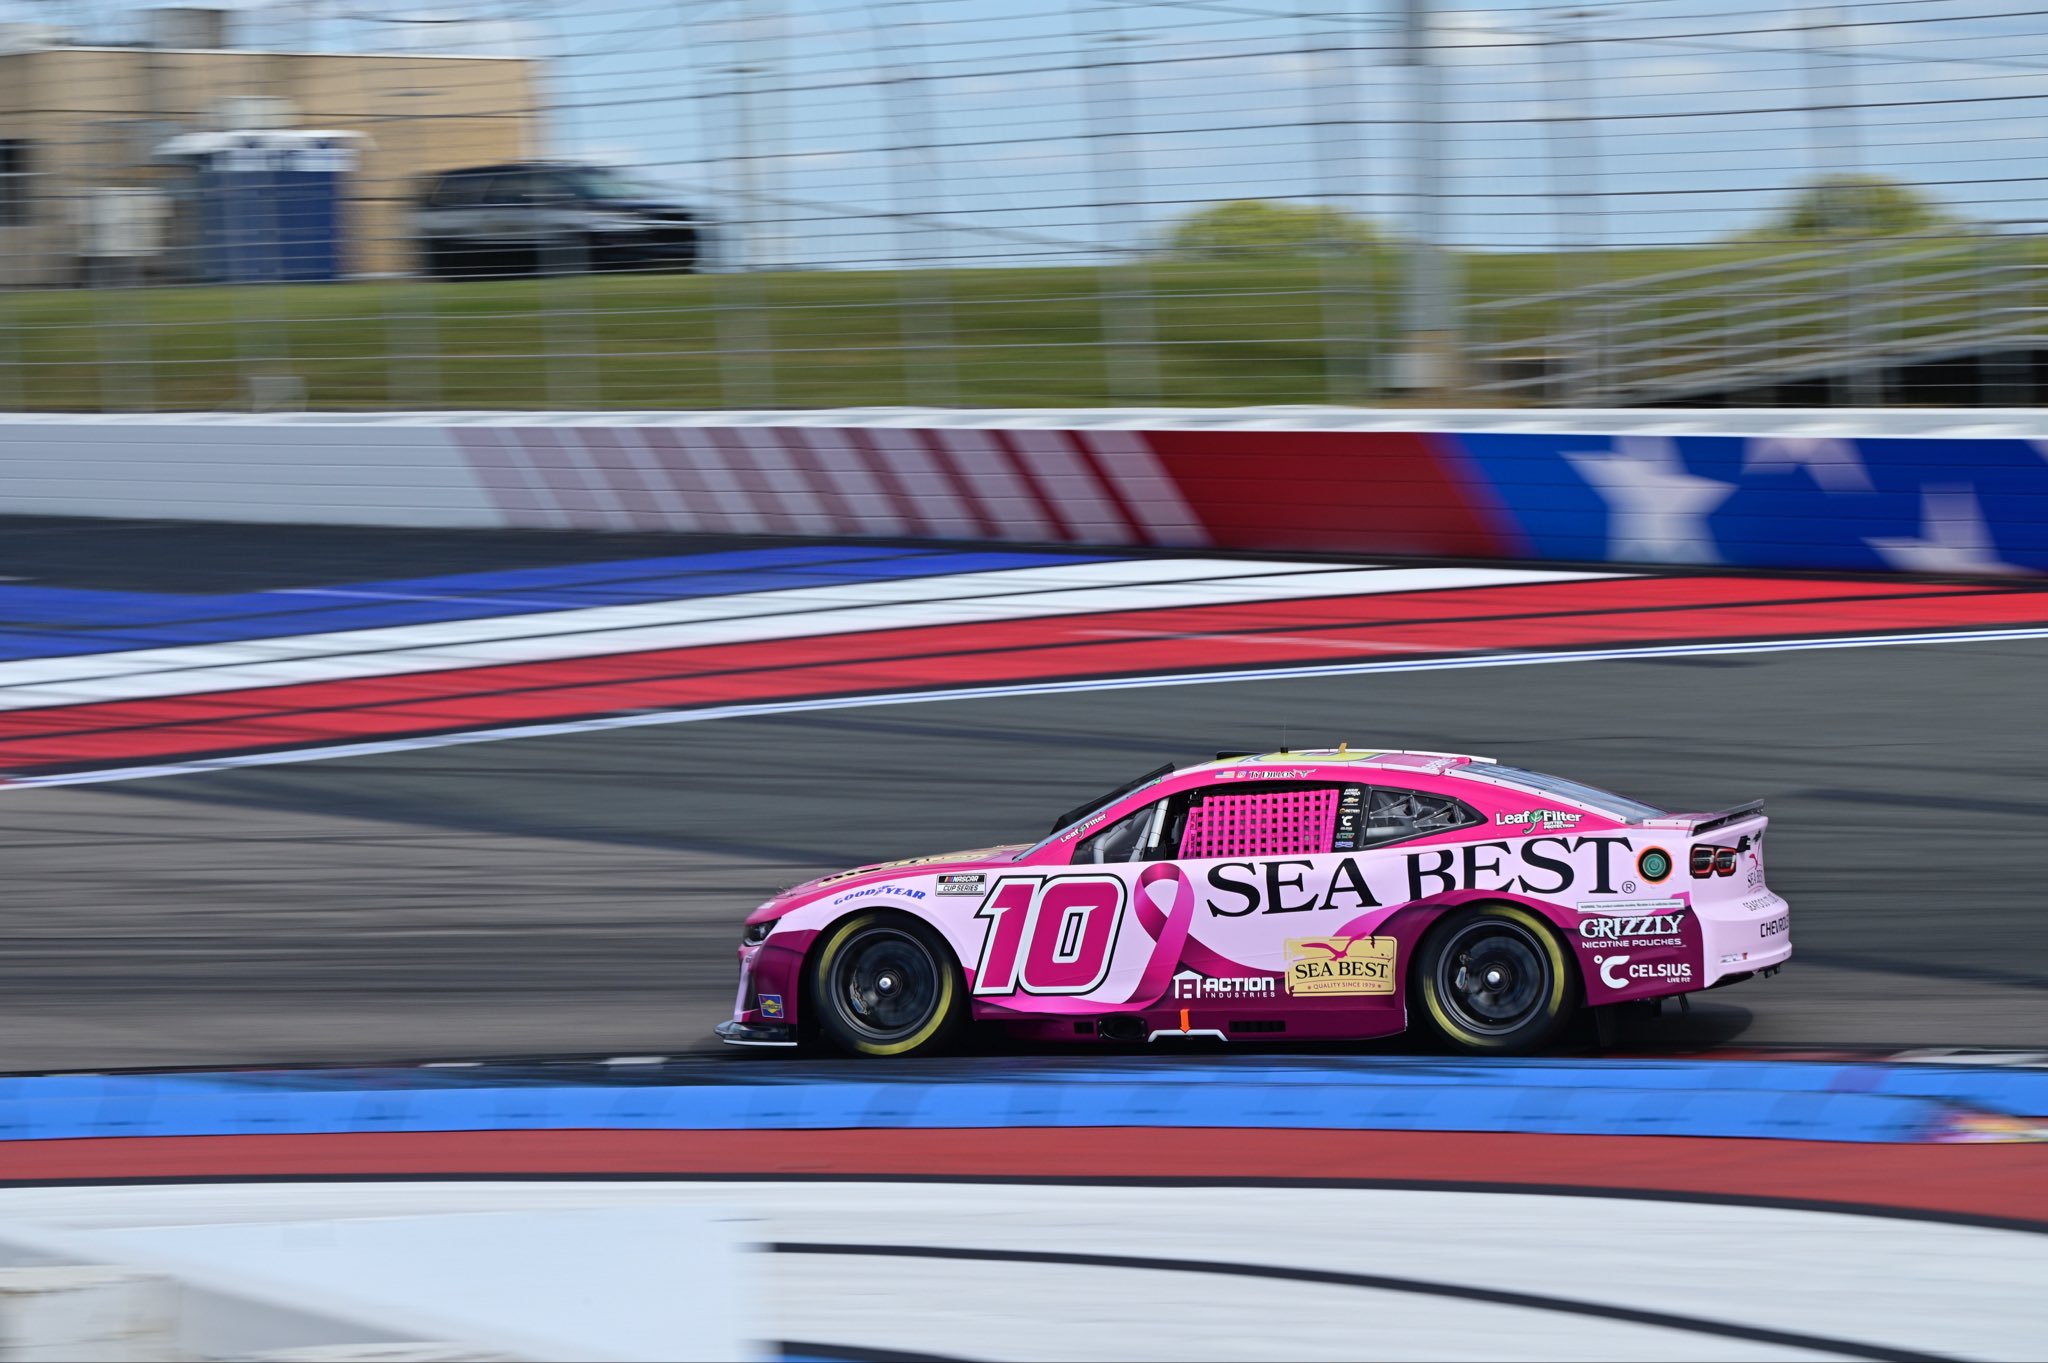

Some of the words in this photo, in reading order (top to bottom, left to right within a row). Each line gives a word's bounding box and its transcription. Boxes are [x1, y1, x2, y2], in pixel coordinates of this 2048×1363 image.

[952, 875, 980, 883] NASCAR
[943, 884, 957, 892] CUP
[957, 884, 979, 892] SERIES
[1206, 857, 1382, 918] SEA
[1579, 915, 1684, 939] GRIZZLY
[973, 873, 1128, 997] 10
[1582, 940, 1630, 949] NICOTINE
[1632, 938, 1681, 946] POUCHES
[1295, 962, 1334, 979] SEA
[1338, 961, 1389, 978] BEST
[1629, 963, 1692, 978] CELSIUS
[1203, 976, 1275, 992] ACTION
[1313, 982, 1341, 990] QUALITY
[1205, 991, 1276, 999] INDUSTRIES
